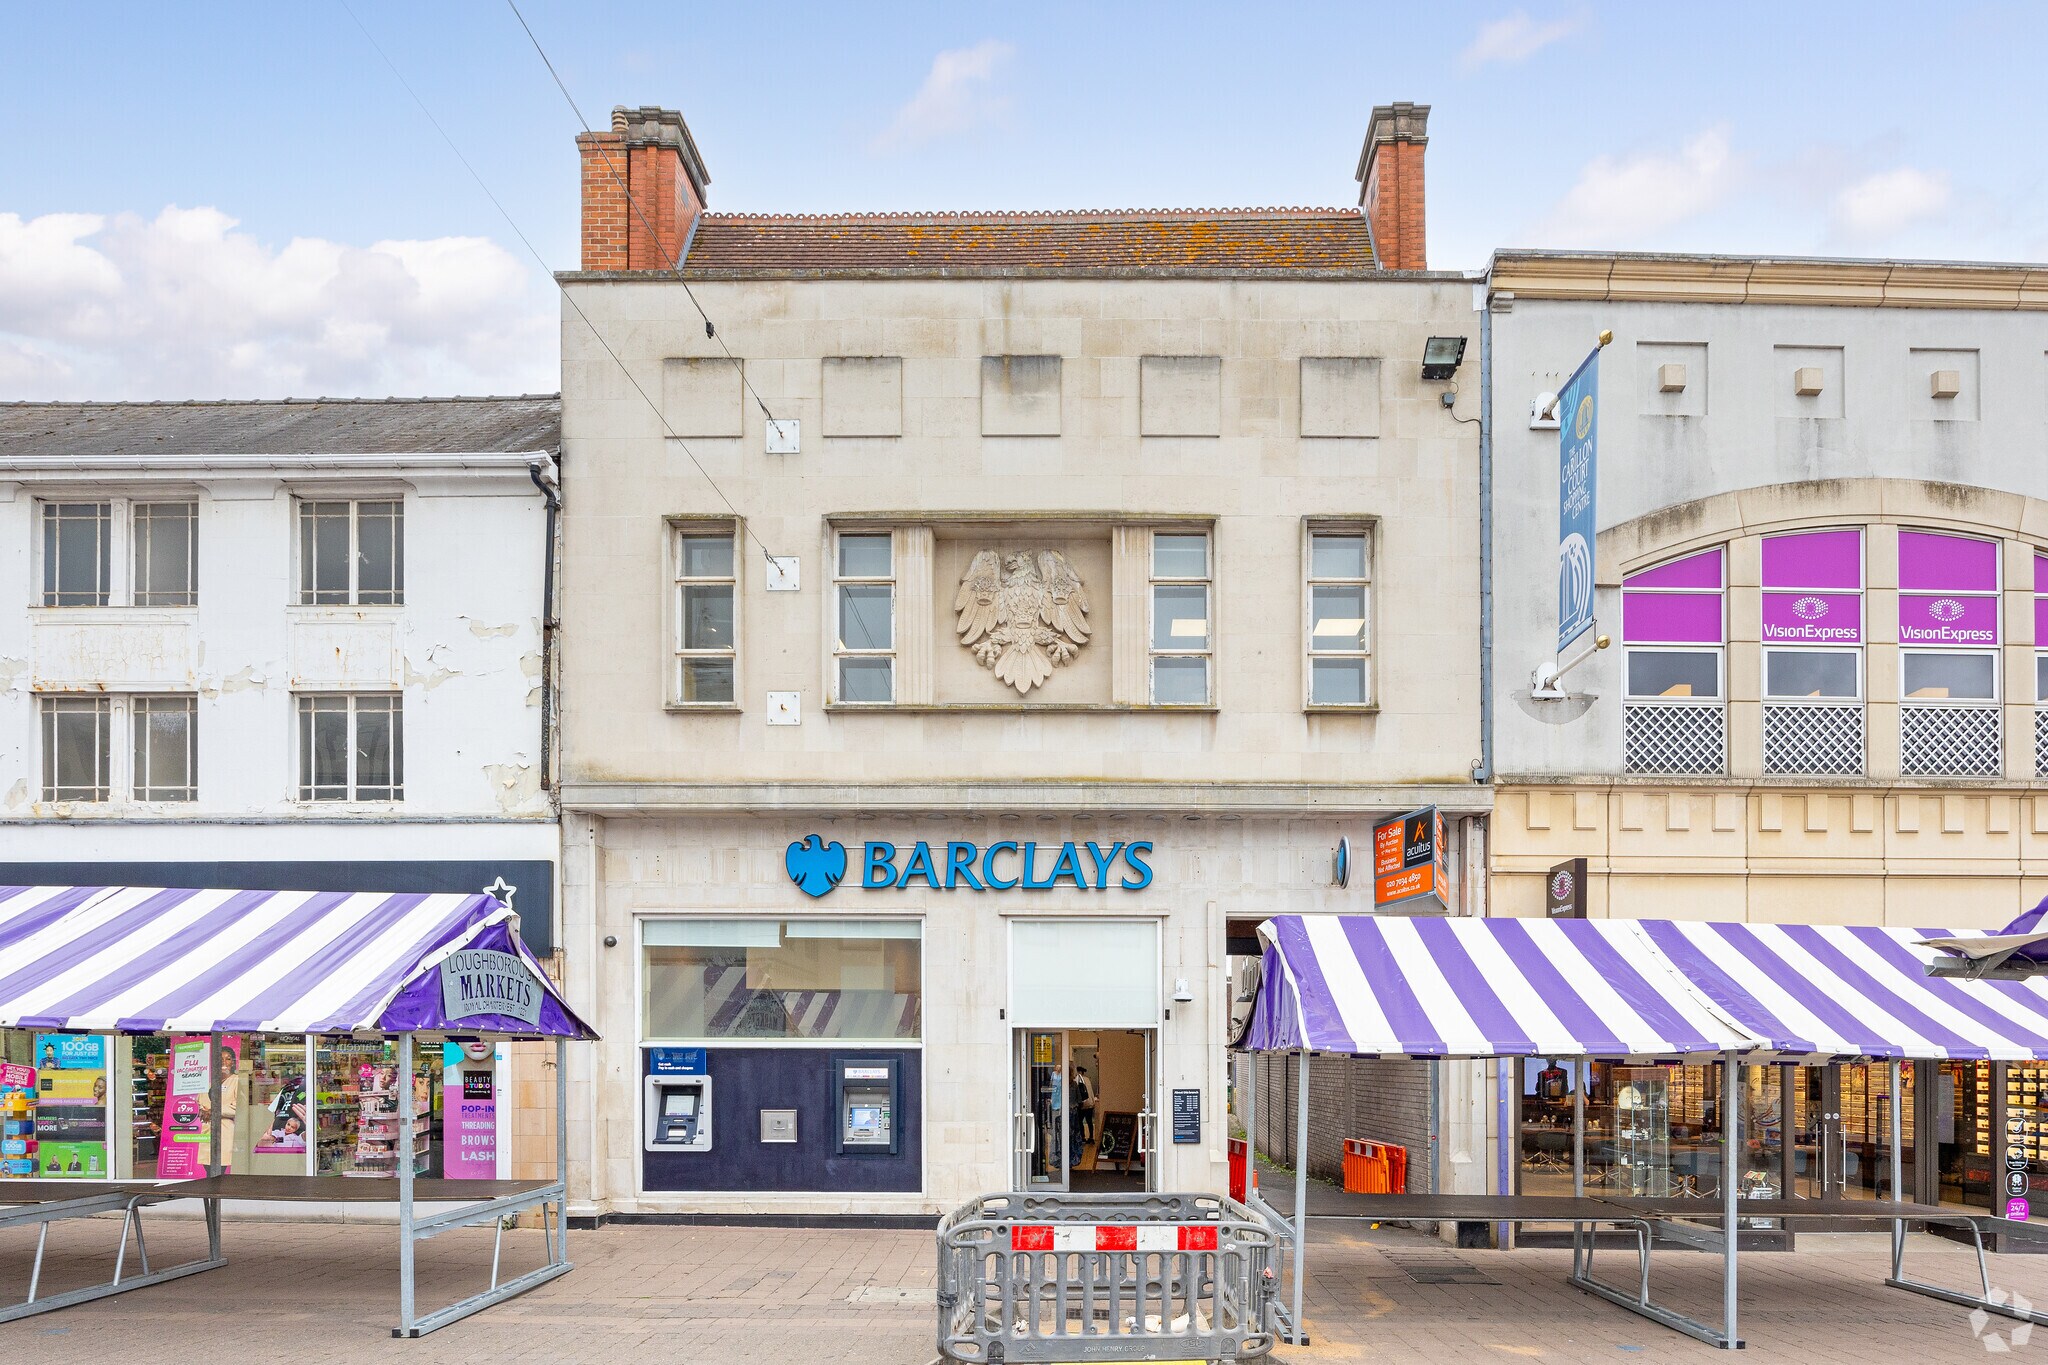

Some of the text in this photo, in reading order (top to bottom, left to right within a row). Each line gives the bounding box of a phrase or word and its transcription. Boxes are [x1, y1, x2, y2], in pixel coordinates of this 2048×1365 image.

[1562, 436, 1593, 484] CARILLON
[1568, 457, 1589, 494] COURT
[1564, 480, 1586, 515] SHOPPING
[1572, 490, 1590, 520] CENTRE
[1378, 827, 1402, 841] For Sale
[1406, 842, 1430, 857] acuitus
[861, 841, 1154, 890] BARCLAYS
[1385, 862, 1400, 871] Affected
[460, 974, 530, 1006] MARKETS
[464, 1002, 481, 1012] ROYAL
[483, 1000, 506, 1010] CHARTER
[61, 1042, 99, 1051] 100GB
[6, 1073, 28, 1081] MOBILE
[462, 1135, 494, 1145] BROWS
[462, 1152, 494, 1160] LASH
